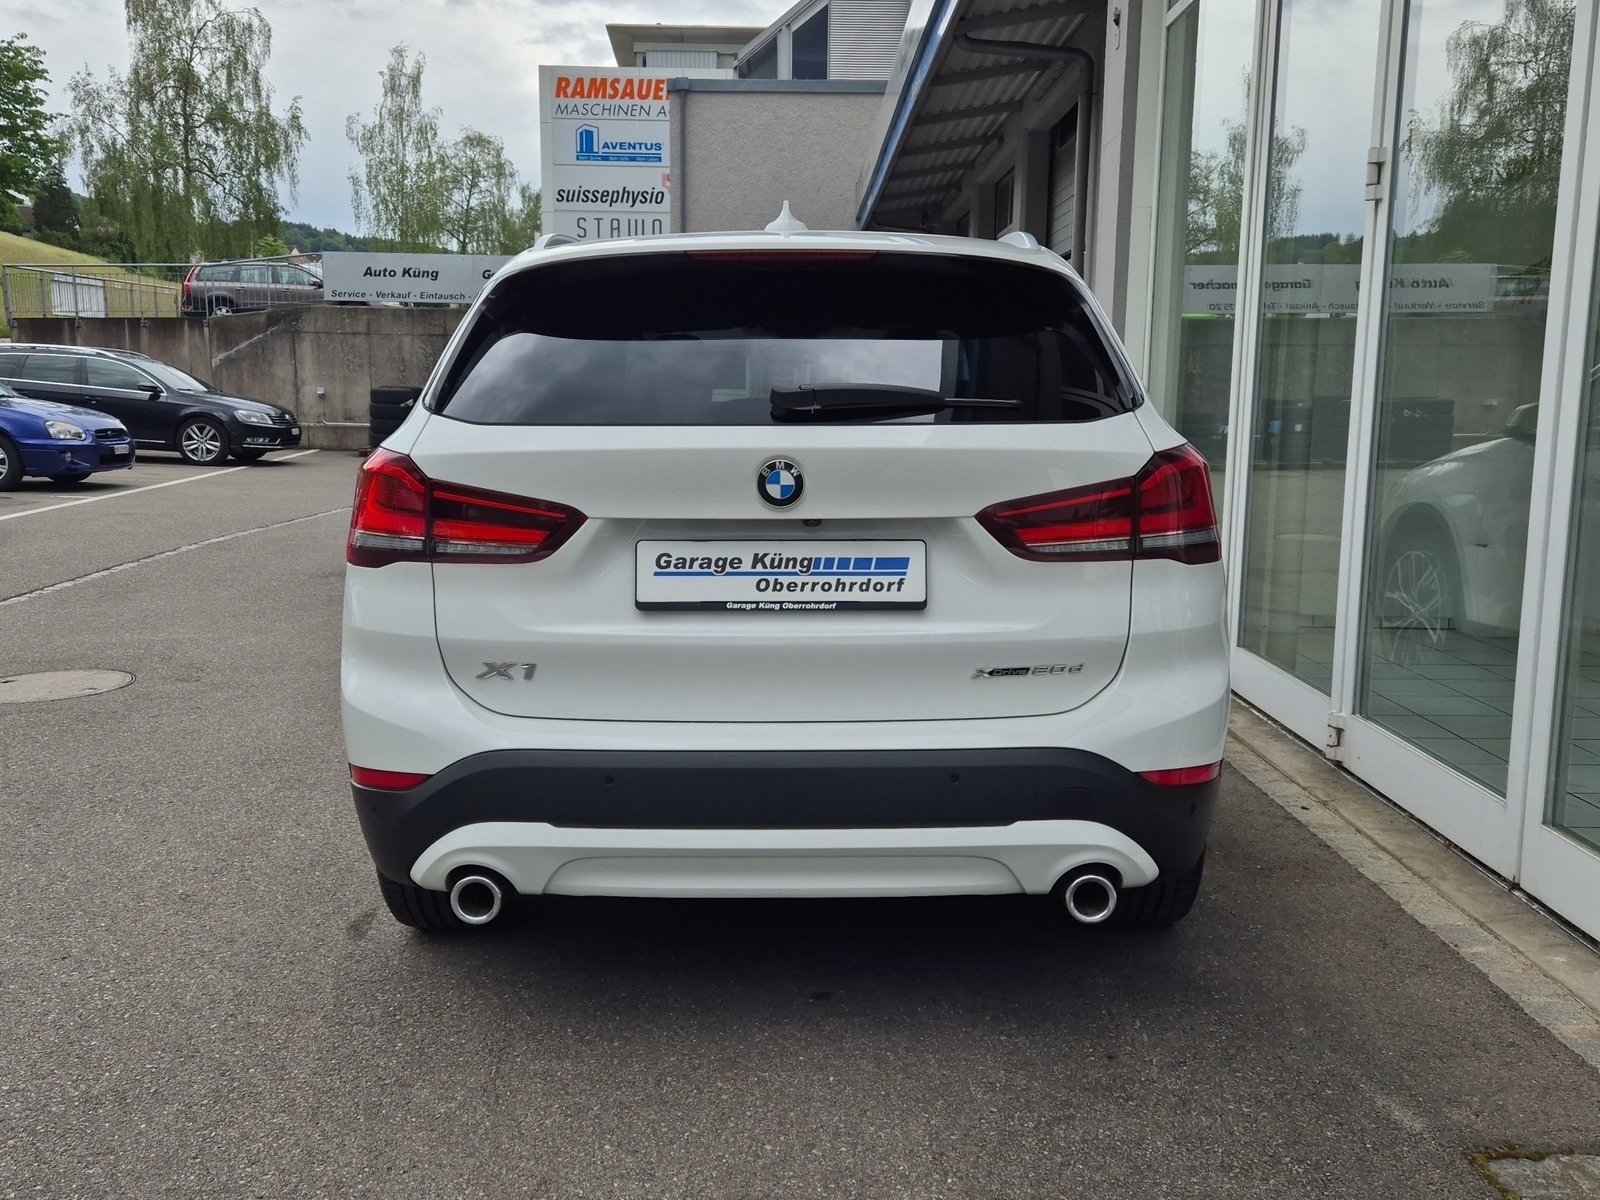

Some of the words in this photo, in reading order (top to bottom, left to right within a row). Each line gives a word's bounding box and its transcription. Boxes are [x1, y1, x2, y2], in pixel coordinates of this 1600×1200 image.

[555, 76, 671, 101] RAMSAUE
[555, 103, 651, 117] MASCHINEN
[657, 105, 670, 118] A
[601, 141, 662, 151] AVENTUS
[556, 186, 664, 207] suissephysio
[363, 267, 396, 278] Auto
[402, 267, 439, 281] Küng
[331, 290, 366, 299] Service
[375, 291, 411, 299] Verkauf
[420, 291, 466, 300] Eintausch
[761, 461, 801, 477] BMW
[655, 552, 743, 573] Garage
[751, 552, 813, 574] Küng
[755, 578, 905, 593] Oberrohrdorf
[726, 602, 757, 610] Garage
[758, 602, 780, 611] Küng
[782, 602, 836, 610] Oberrohrdorf
[476, 662, 537, 680] X1
